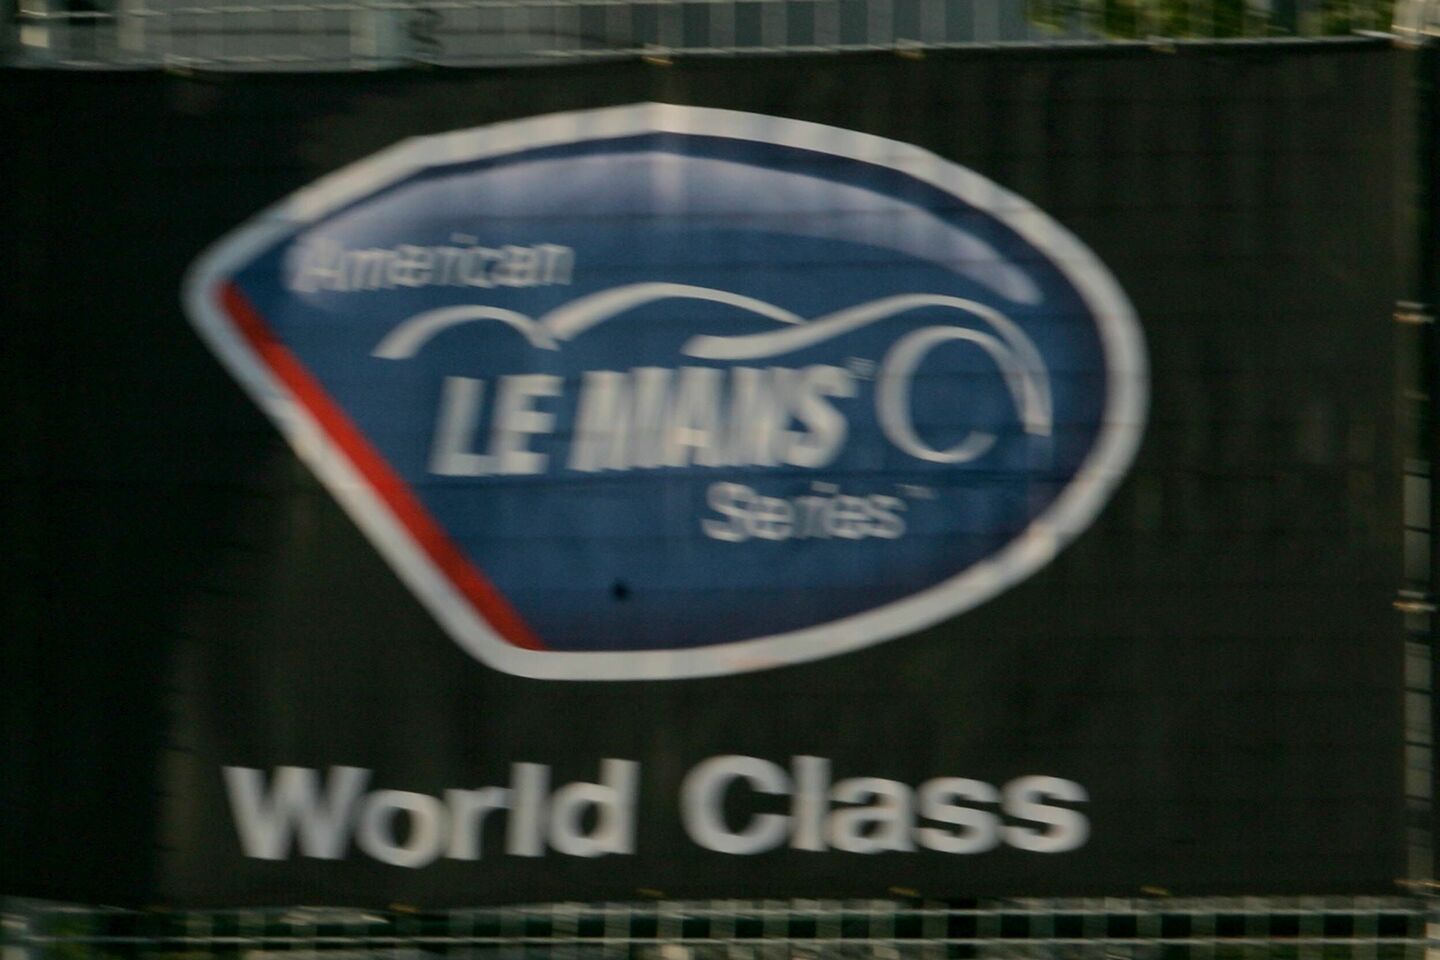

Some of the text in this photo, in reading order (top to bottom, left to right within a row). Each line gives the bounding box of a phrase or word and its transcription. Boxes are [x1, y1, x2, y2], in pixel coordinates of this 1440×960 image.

[287, 236, 574, 292] American
[428, 364, 857, 476] LE MANS
[701, 482, 908, 543] Series
[222, 754, 1091, 868] World Class
